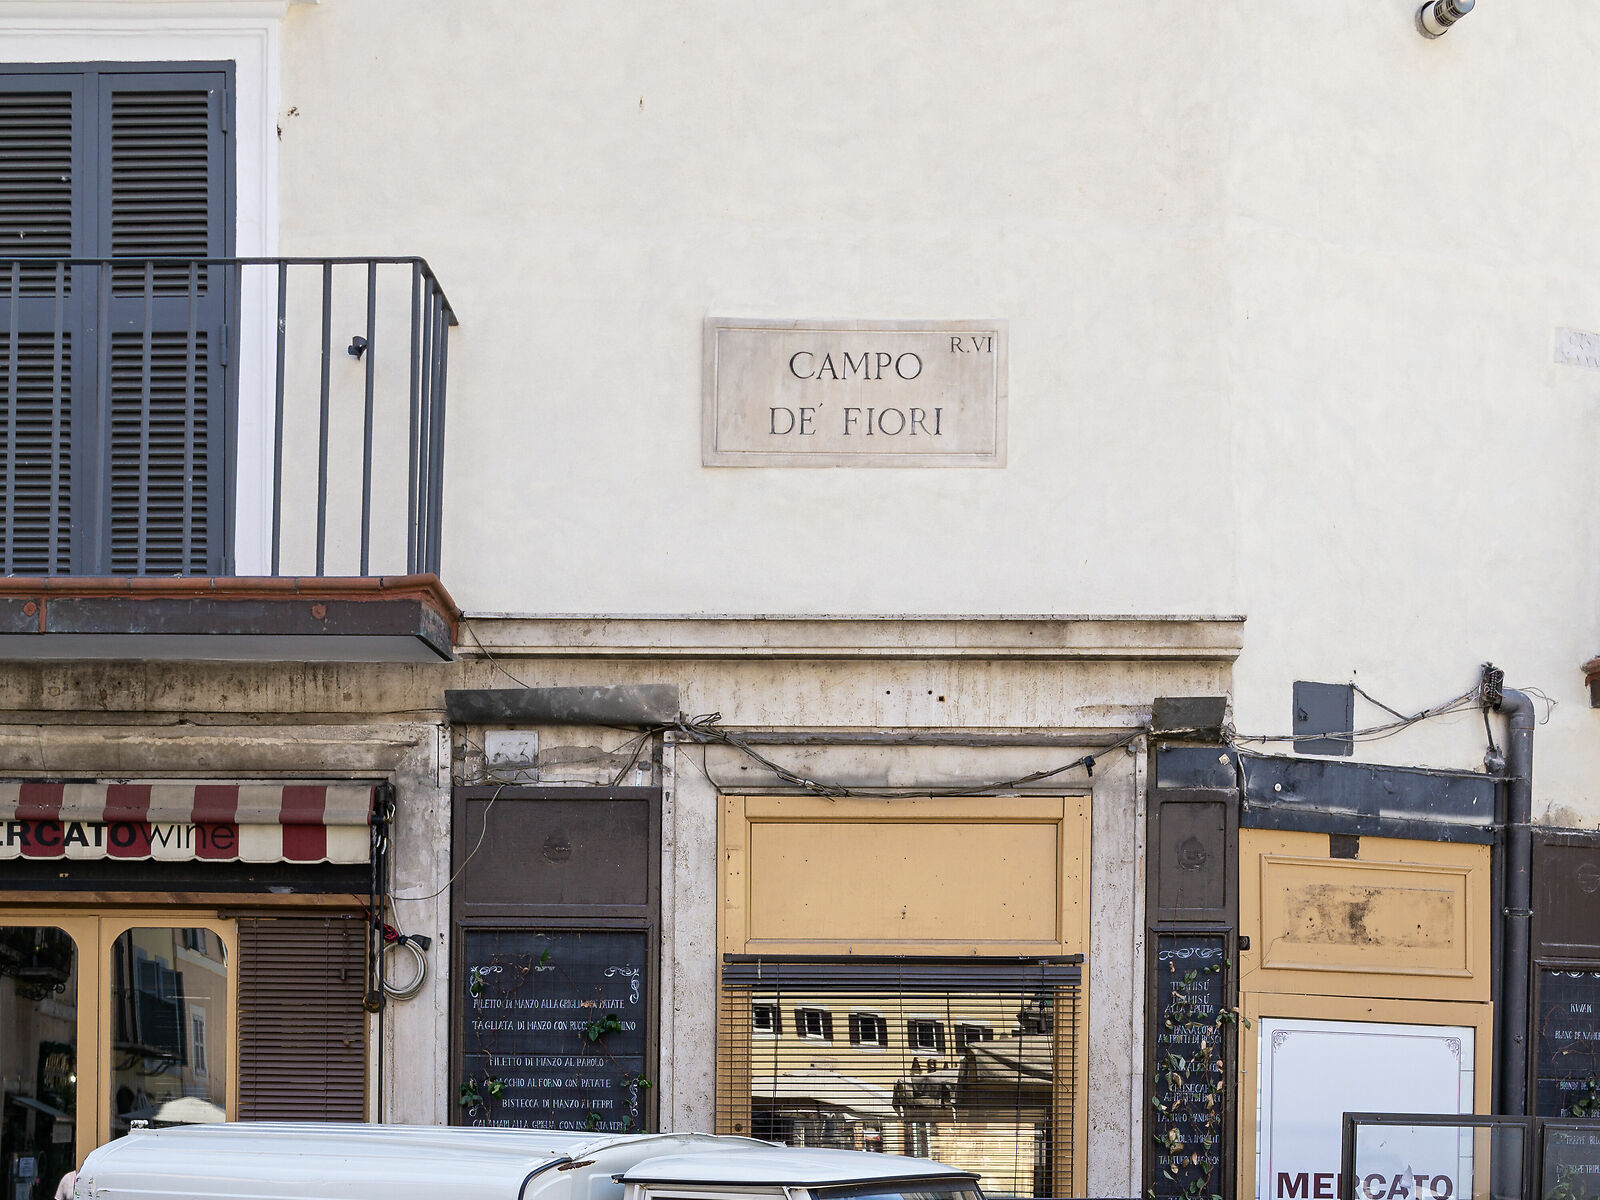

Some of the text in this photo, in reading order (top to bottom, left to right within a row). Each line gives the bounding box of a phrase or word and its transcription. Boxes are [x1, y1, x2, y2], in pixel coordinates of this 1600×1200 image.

[950, 336, 993, 353] R.VI
[789, 351, 923, 380] CAMPO
[842, 407, 943, 436] FIORI
[472, 1020, 514, 1030] TAGLIATA
[517, 1020, 525, 1030] DI
[526, 1020, 552, 1030] MANZO
[554, 1020, 568, 1030] CON
[489, 1057, 522, 1067] FILETTO
[525, 1057, 532, 1067] DI
[536, 1057, 562, 1067] MANZO
[564, 1057, 574, 1067] AL
[527, 1078, 538, 1088] AL
[538, 1078, 562, 1088] FORNO
[581, 1078, 612, 1088] PATATE
[502, 1099, 538, 1108] BISTECCA
[542, 1099, 550, 1108] DI
[552, 1099, 580, 1108] MANZO
